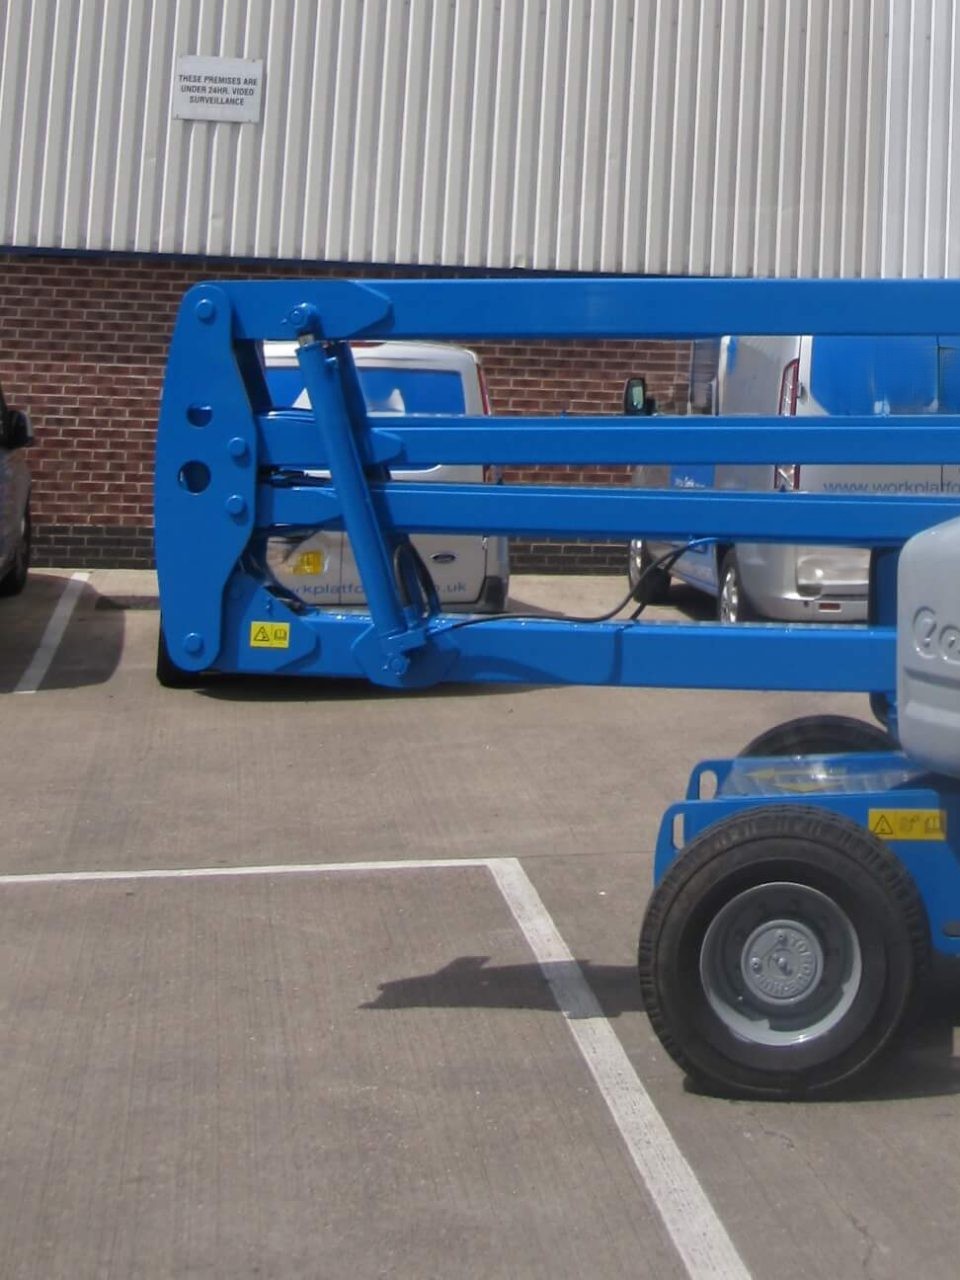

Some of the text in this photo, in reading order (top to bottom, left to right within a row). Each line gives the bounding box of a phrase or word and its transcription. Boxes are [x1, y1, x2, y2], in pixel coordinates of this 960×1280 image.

[178, 74, 258, 86] THESE PREMISES ARE
[180, 85, 207, 94] UNDER
[232, 87, 254, 96] VIDEO
[189, 95, 245, 106] SURVEILLANCE
